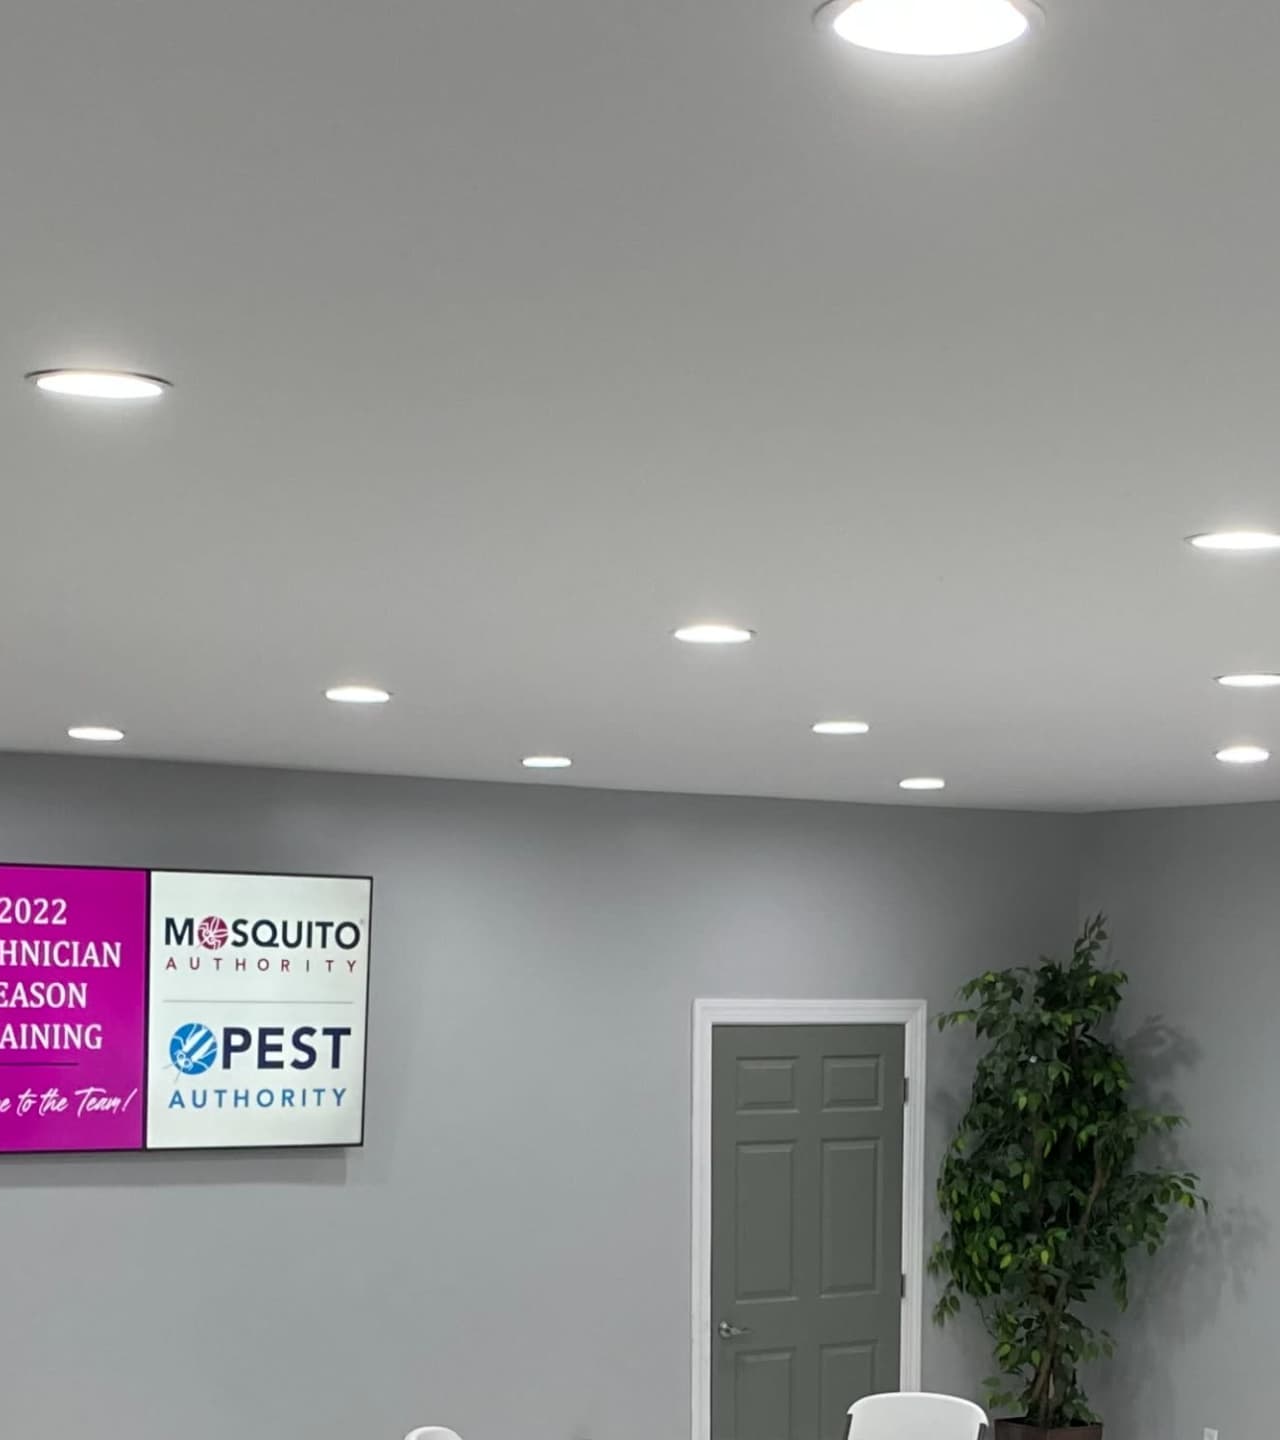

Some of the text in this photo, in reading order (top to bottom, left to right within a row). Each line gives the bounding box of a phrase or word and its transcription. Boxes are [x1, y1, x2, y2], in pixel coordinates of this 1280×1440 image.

[164, 916, 362, 950] MOSQUITO
[165, 957, 358, 974] AUTHORITY
[222, 1026, 352, 1070] PEST
[16, 1087, 37, 1117] to
[38, 1087, 69, 1118] the
[74, 1086, 138, 1119] Team!
[168, 1087, 348, 1111] AUTHORITY
